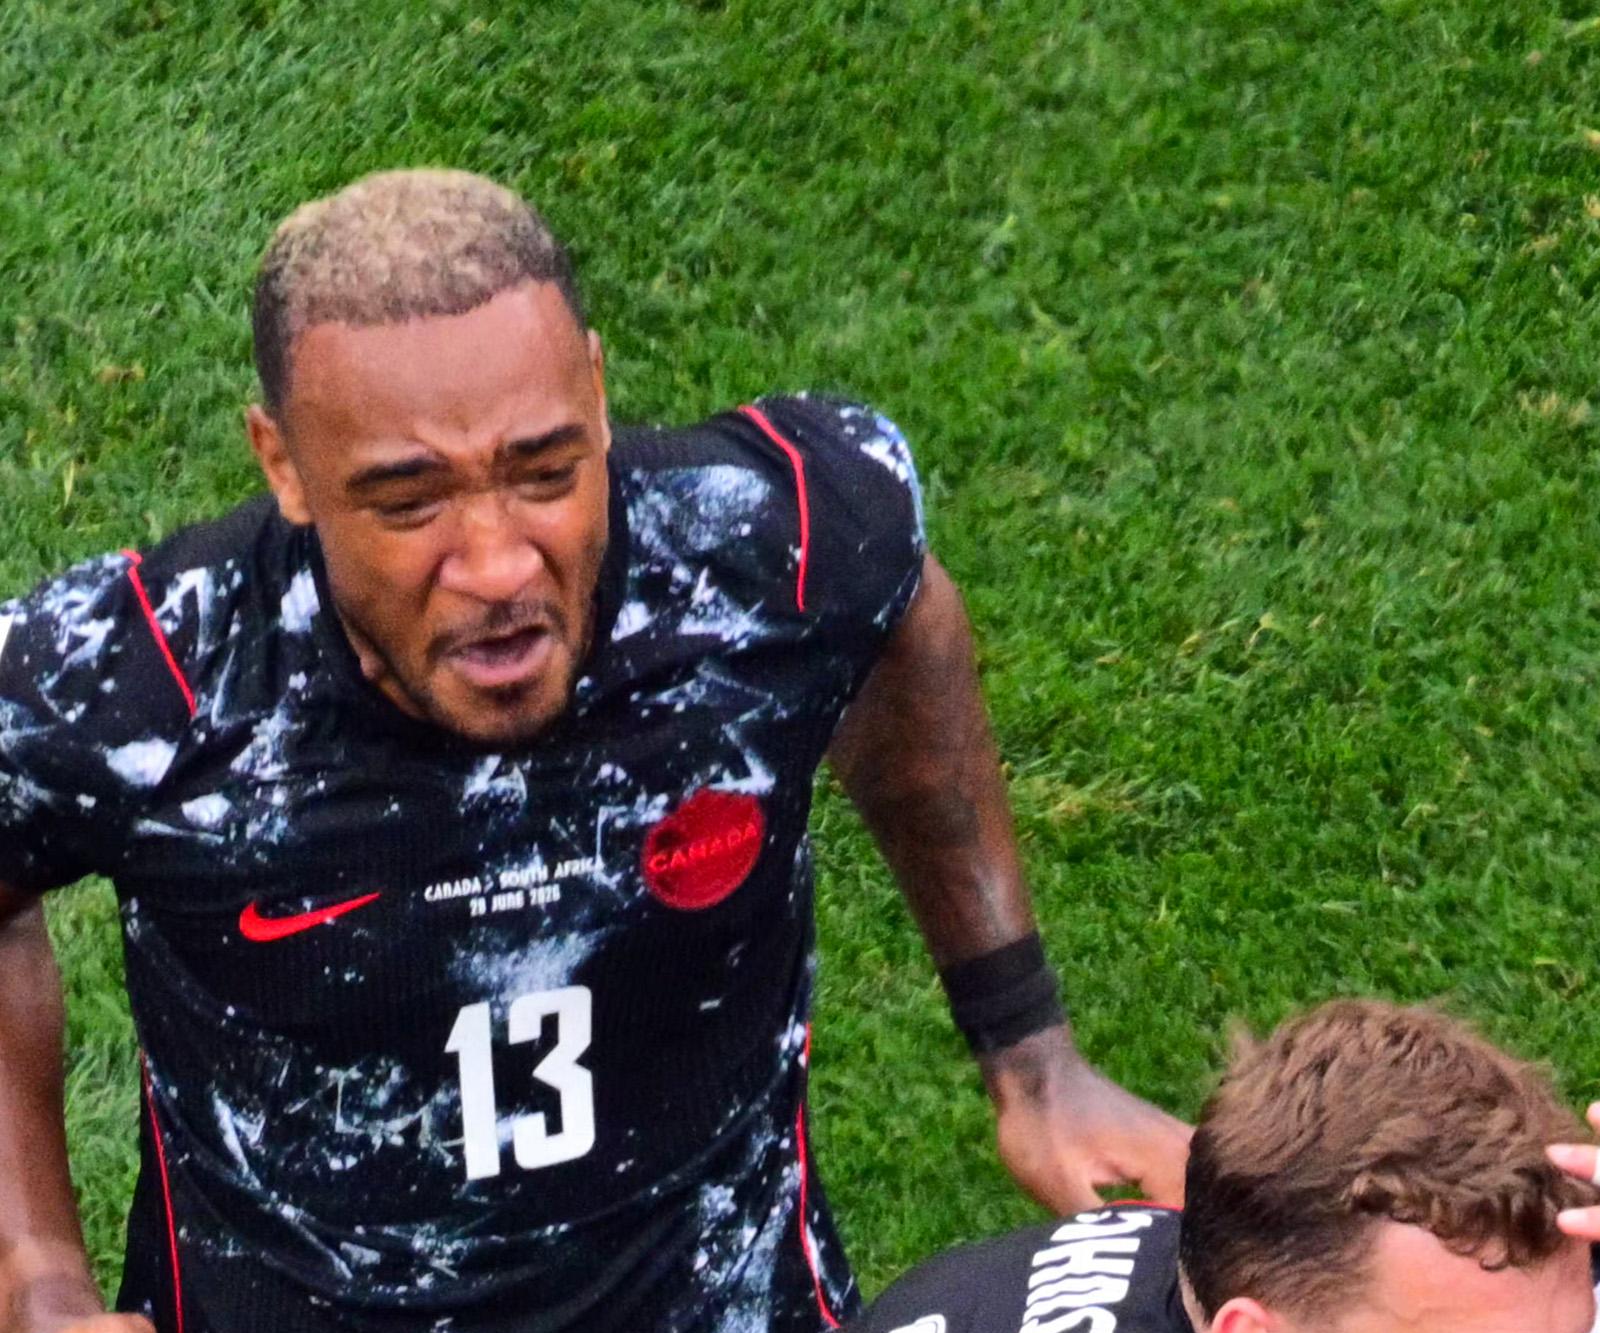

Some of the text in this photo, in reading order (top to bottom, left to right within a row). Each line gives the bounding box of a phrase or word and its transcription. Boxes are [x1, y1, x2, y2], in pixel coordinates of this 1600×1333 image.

[424, 856, 604, 902] CANADA SOUTH AFRICA
[491, 890, 525, 912] JUNE
[530, 884, 561, 905] 2026
[444, 985, 596, 1180] 13
